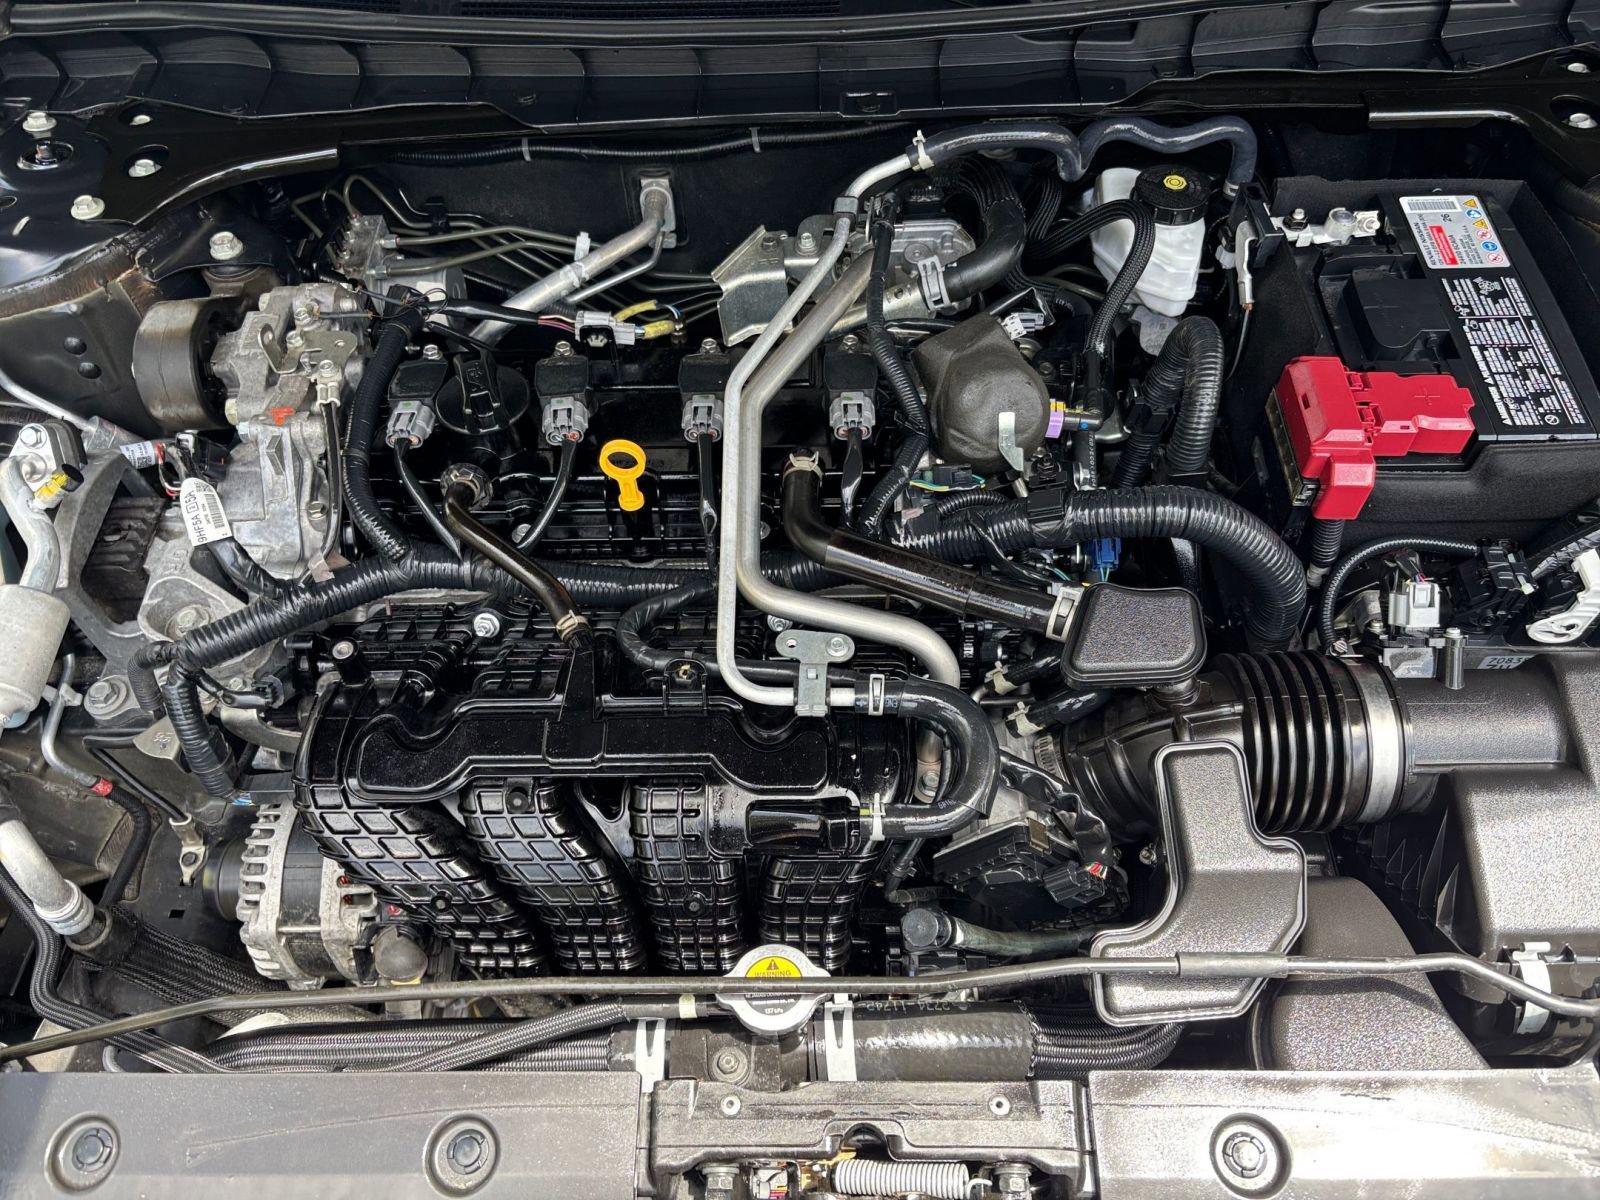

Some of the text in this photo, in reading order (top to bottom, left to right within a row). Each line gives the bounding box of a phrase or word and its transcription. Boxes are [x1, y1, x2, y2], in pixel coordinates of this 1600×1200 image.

[1413, 222, 1427, 244] NISSAN
[191, 513, 208, 543] 9HF5A
[754, 969, 792, 977] WARNING
